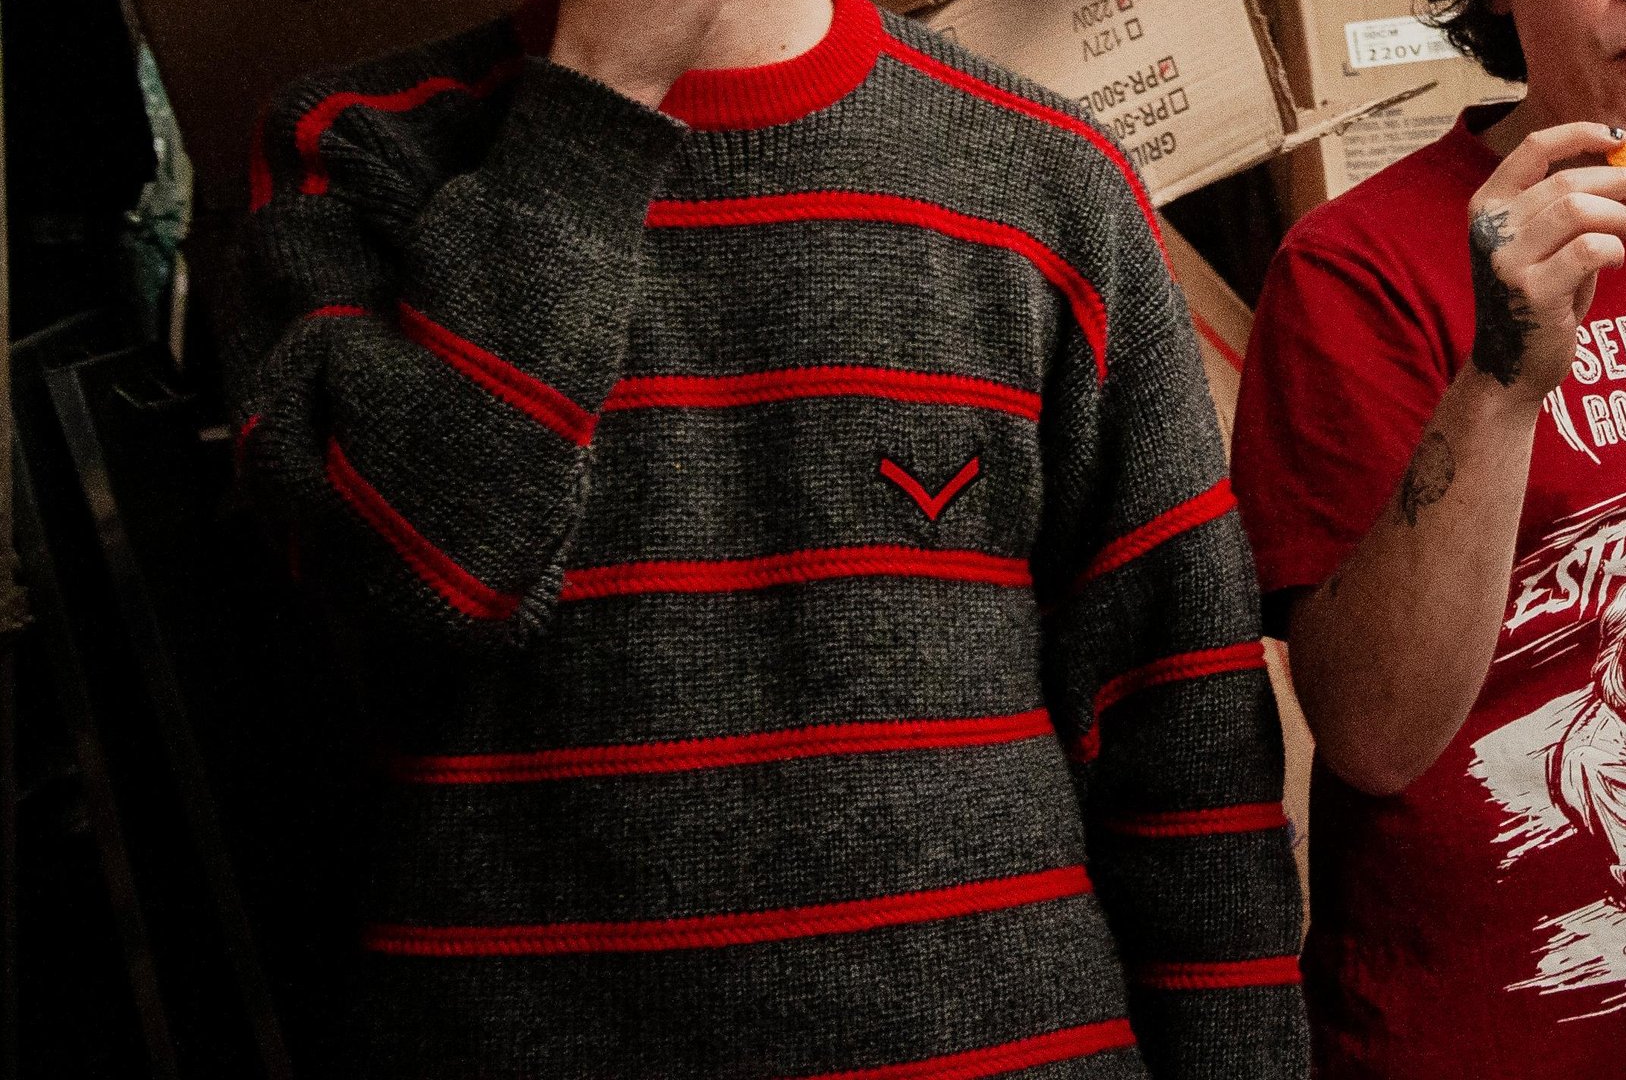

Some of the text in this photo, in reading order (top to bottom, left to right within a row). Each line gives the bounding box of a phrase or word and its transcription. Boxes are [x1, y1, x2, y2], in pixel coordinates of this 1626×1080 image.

[1082, 28, 1122, 62] 127V
[1369, 44, 1422, 62] 220V
[1130, 131, 1177, 168] GRIL
